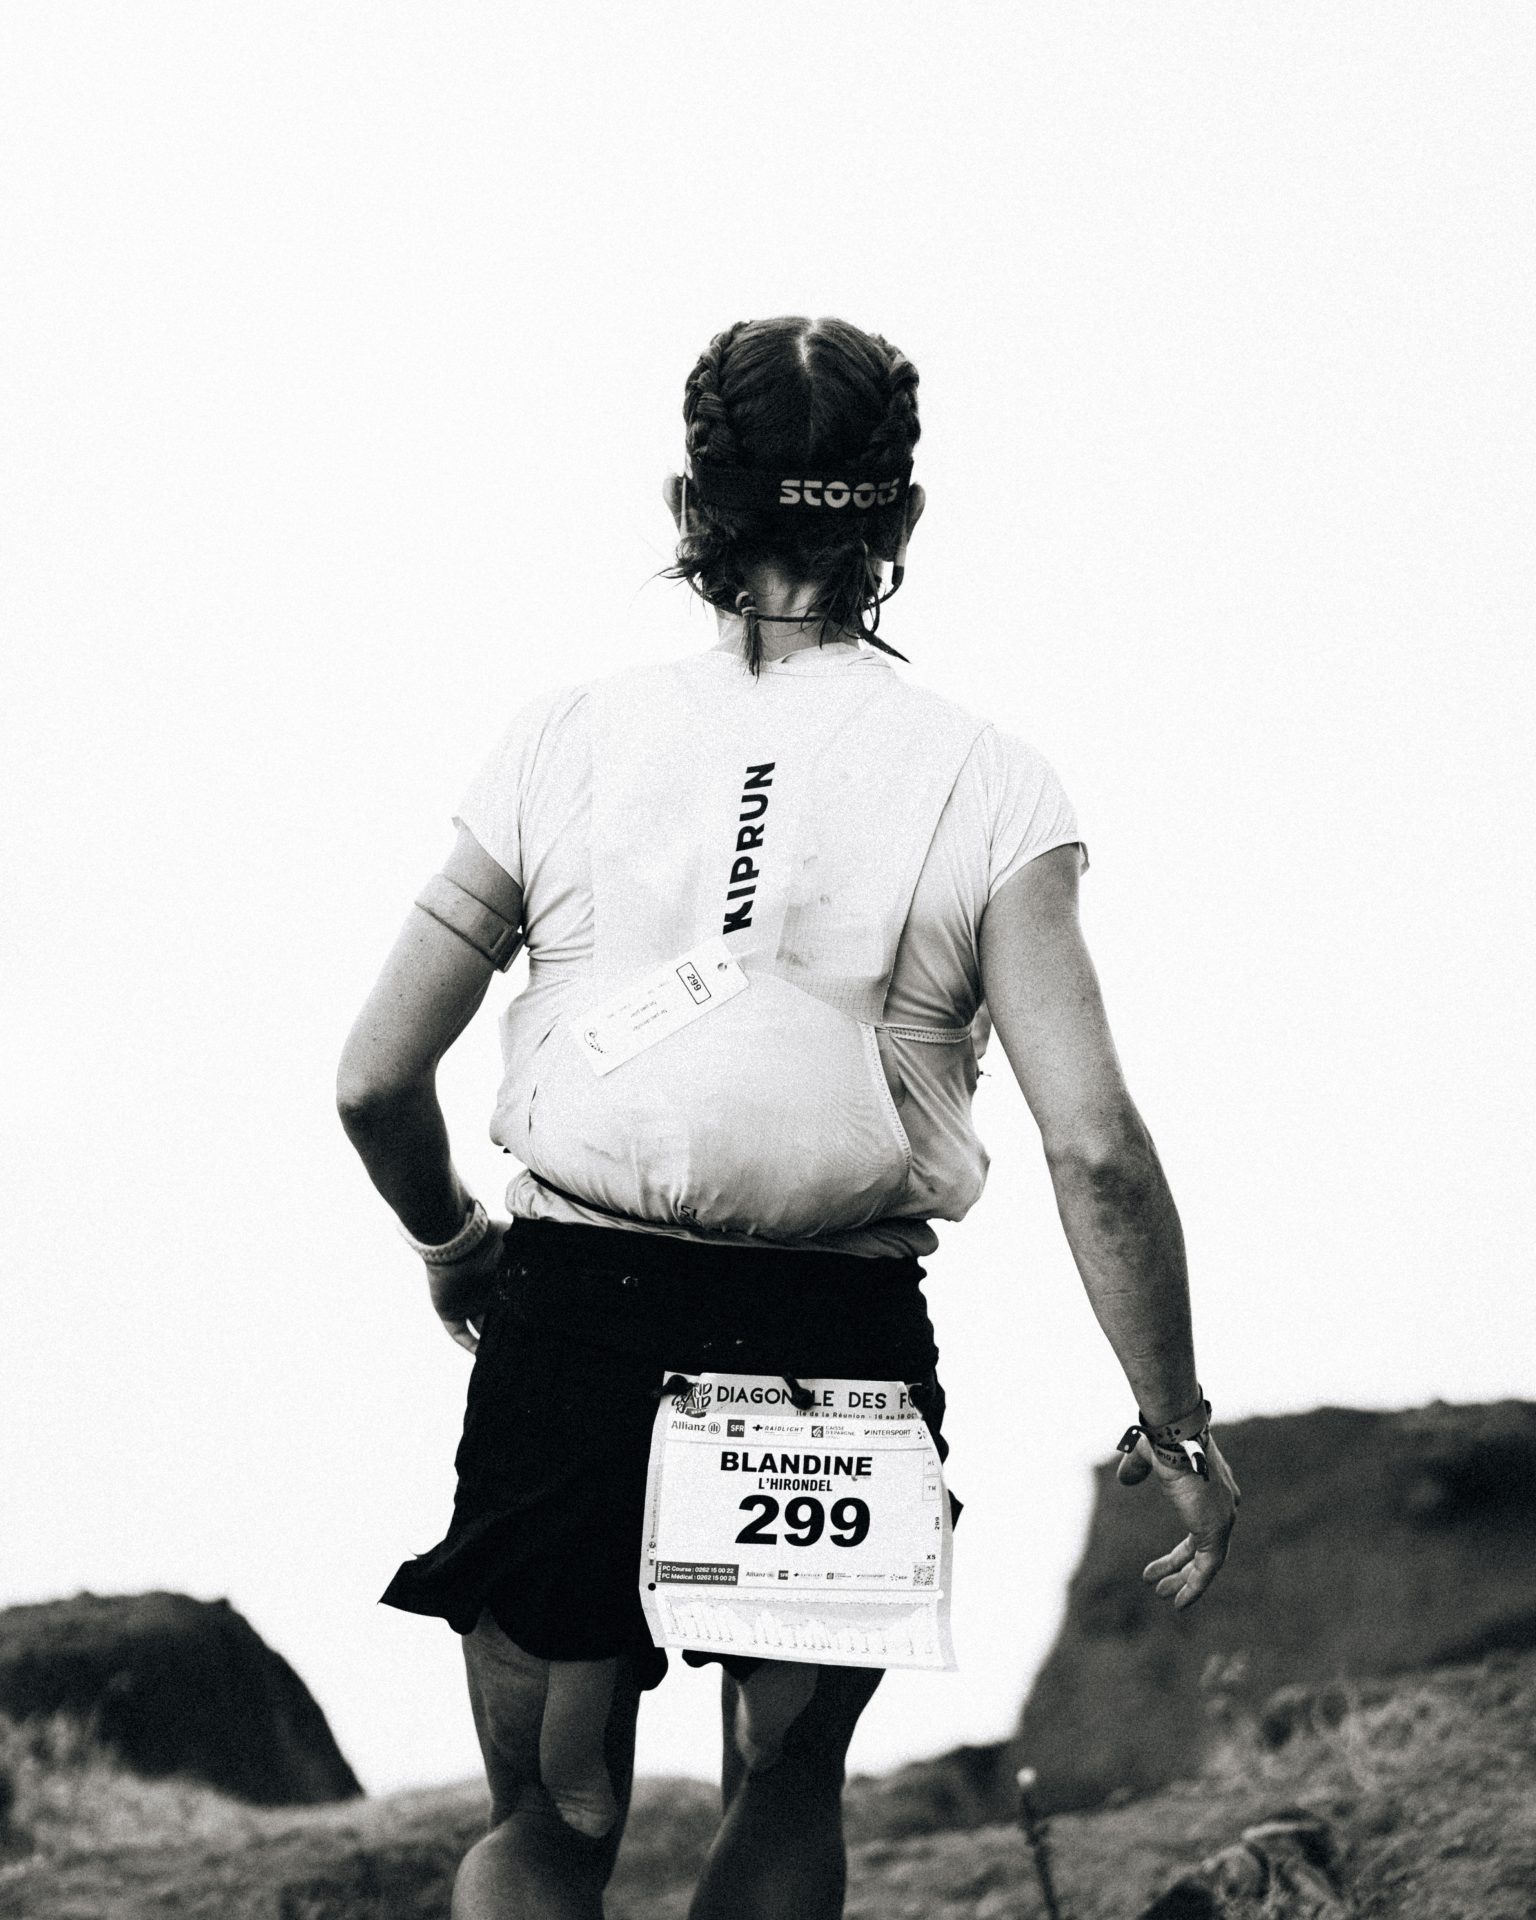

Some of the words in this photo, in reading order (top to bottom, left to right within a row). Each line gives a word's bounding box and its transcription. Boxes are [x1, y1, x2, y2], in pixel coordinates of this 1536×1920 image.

[723, 762, 776, 935] KIPRUN
[687, 973, 702, 991] 299
[717, 1386, 834, 1407] DIAGONLE
[848, 1392, 887, 1409] DES
[833, 1411, 865, 1419] Réunion
[671, 1420, 706, 1432] Allianz
[730, 1424, 745, 1432] SFR
[720, 1451, 873, 1476] BLANDINE
[758, 1478, 833, 1491] L'HIRONDEL
[735, 1494, 871, 1547] 299
